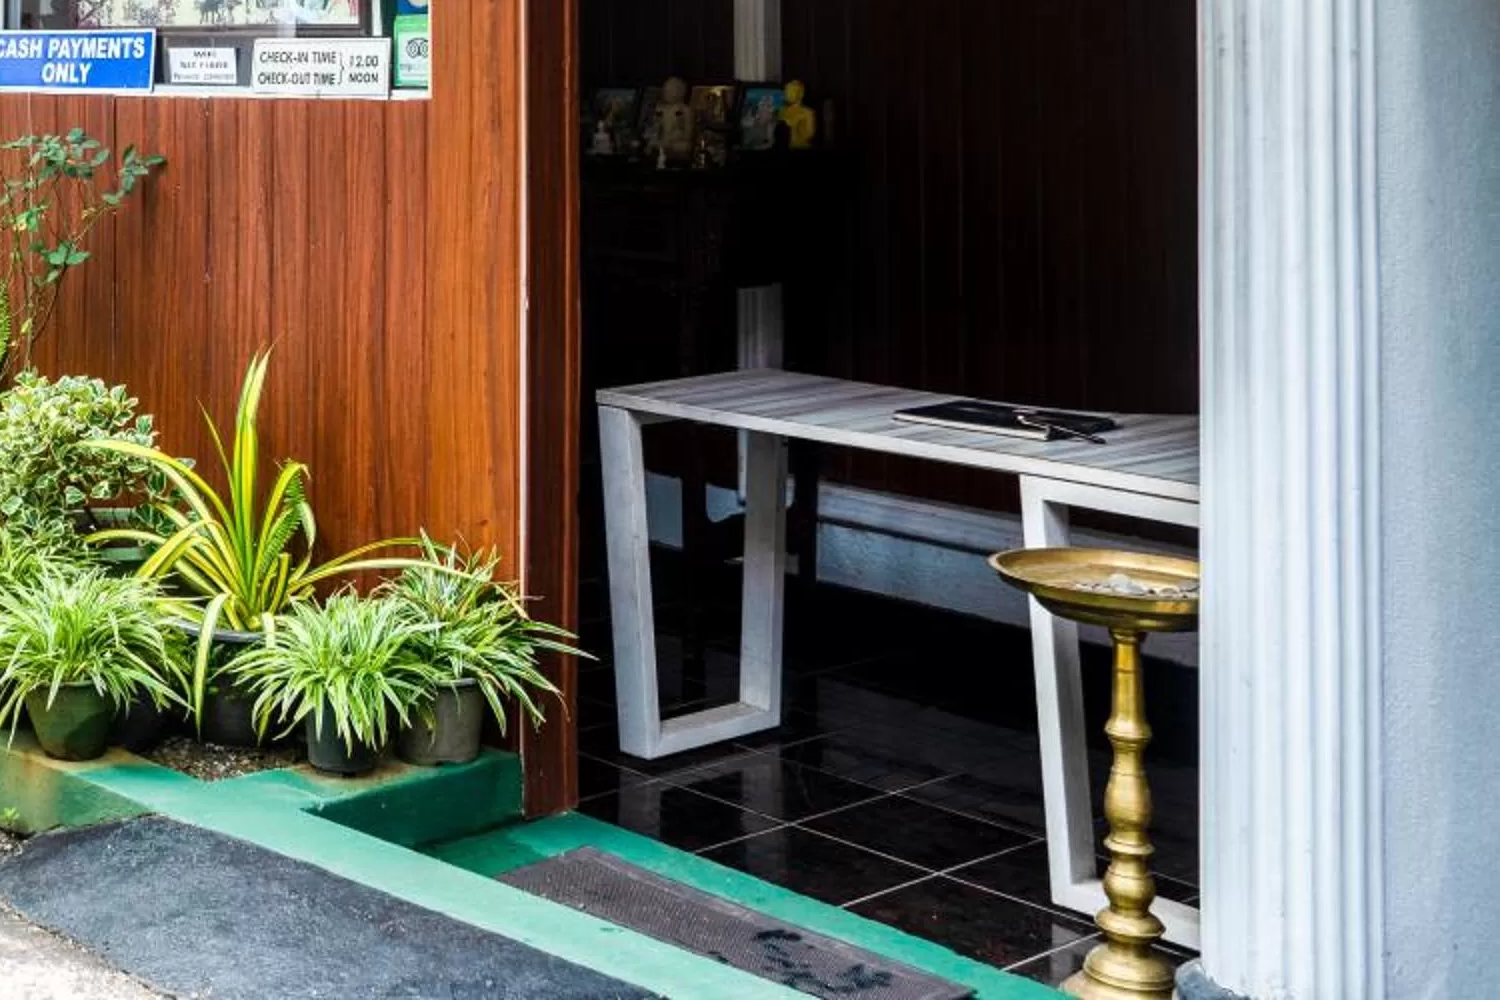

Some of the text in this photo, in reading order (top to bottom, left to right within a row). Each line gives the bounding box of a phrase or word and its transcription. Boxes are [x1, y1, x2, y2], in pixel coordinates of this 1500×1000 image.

[47, 36, 146, 59] PAYMENTS
[259, 51, 337, 64] CHECK-IN TIME
[41, 62, 92, 83] ONLY
[257, 71, 336, 85] CHECK-OUT TIME
[349, 73, 379, 83] NOON
